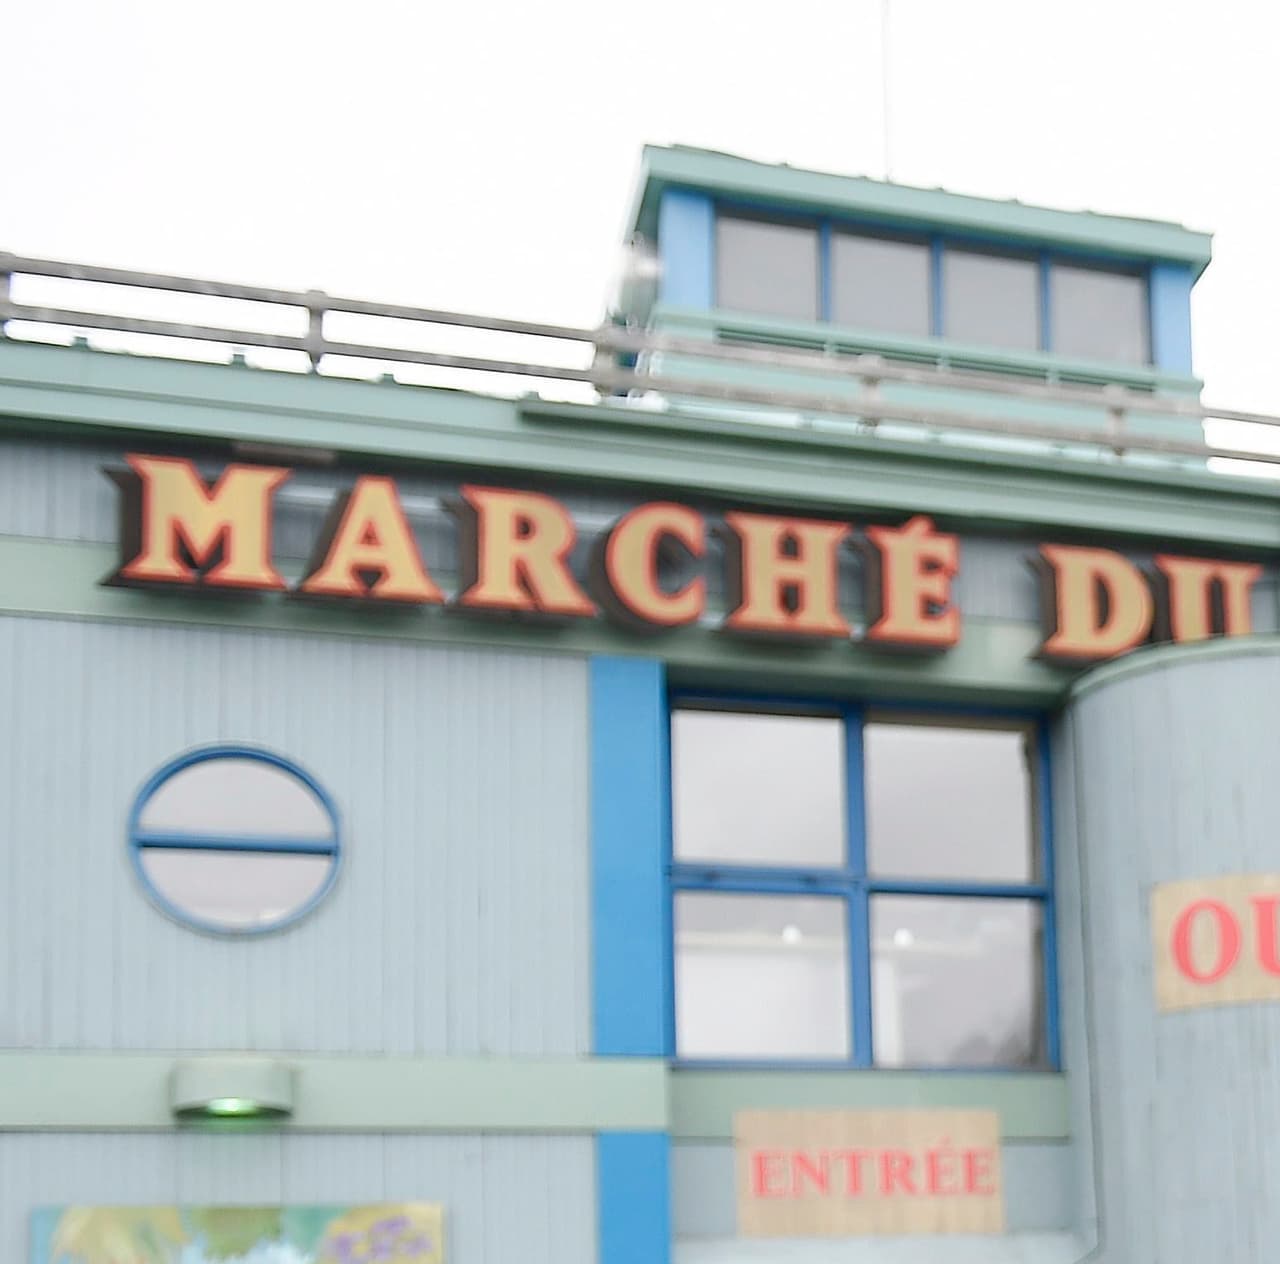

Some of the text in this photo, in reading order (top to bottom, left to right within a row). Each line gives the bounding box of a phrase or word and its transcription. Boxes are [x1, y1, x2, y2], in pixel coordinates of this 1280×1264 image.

[114, 453, 960, 648] MARCHÉ
[1037, 542, 1264, 659] DU
[750, 1136, 996, 1199] ENTRÉE
